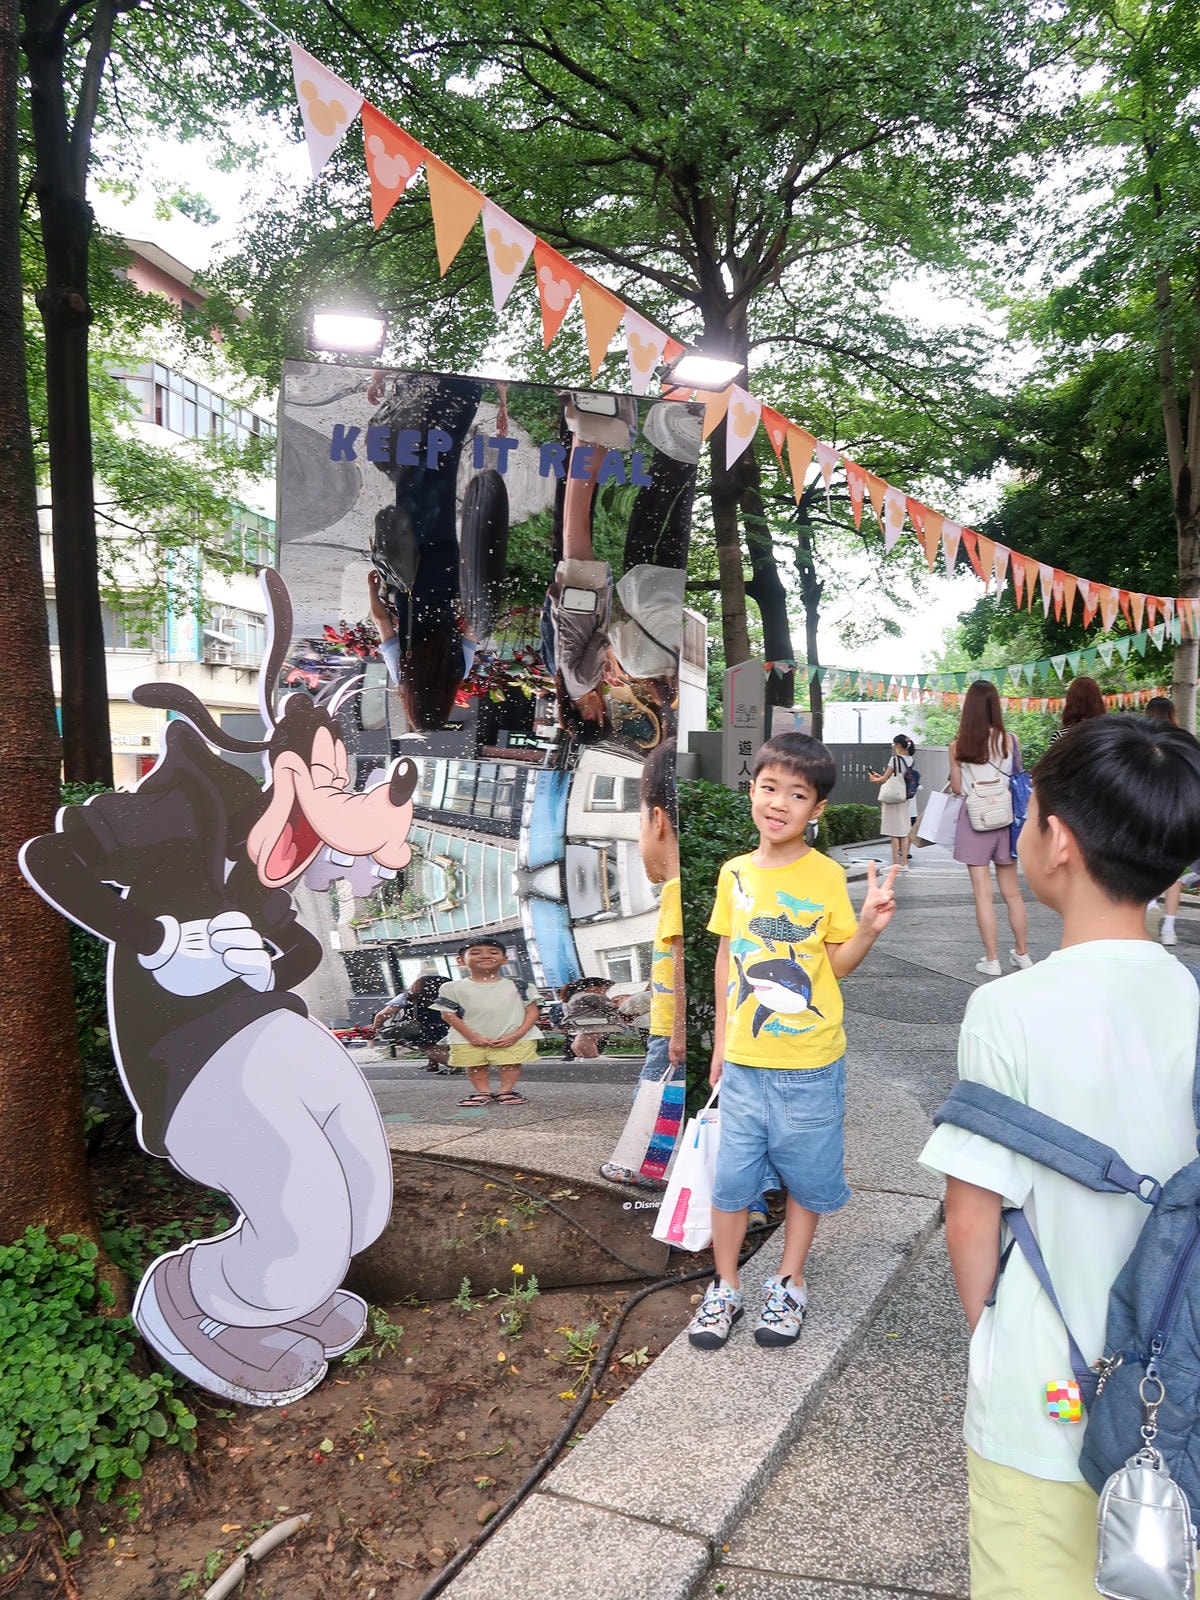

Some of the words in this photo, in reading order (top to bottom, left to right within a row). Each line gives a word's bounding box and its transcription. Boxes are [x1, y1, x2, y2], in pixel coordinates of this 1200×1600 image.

[329, 423, 453, 470] KEEP
[472, 434, 518, 474] IT
[538, 442, 653, 487] REAL
[634, 1201, 662, 1209] Disne
